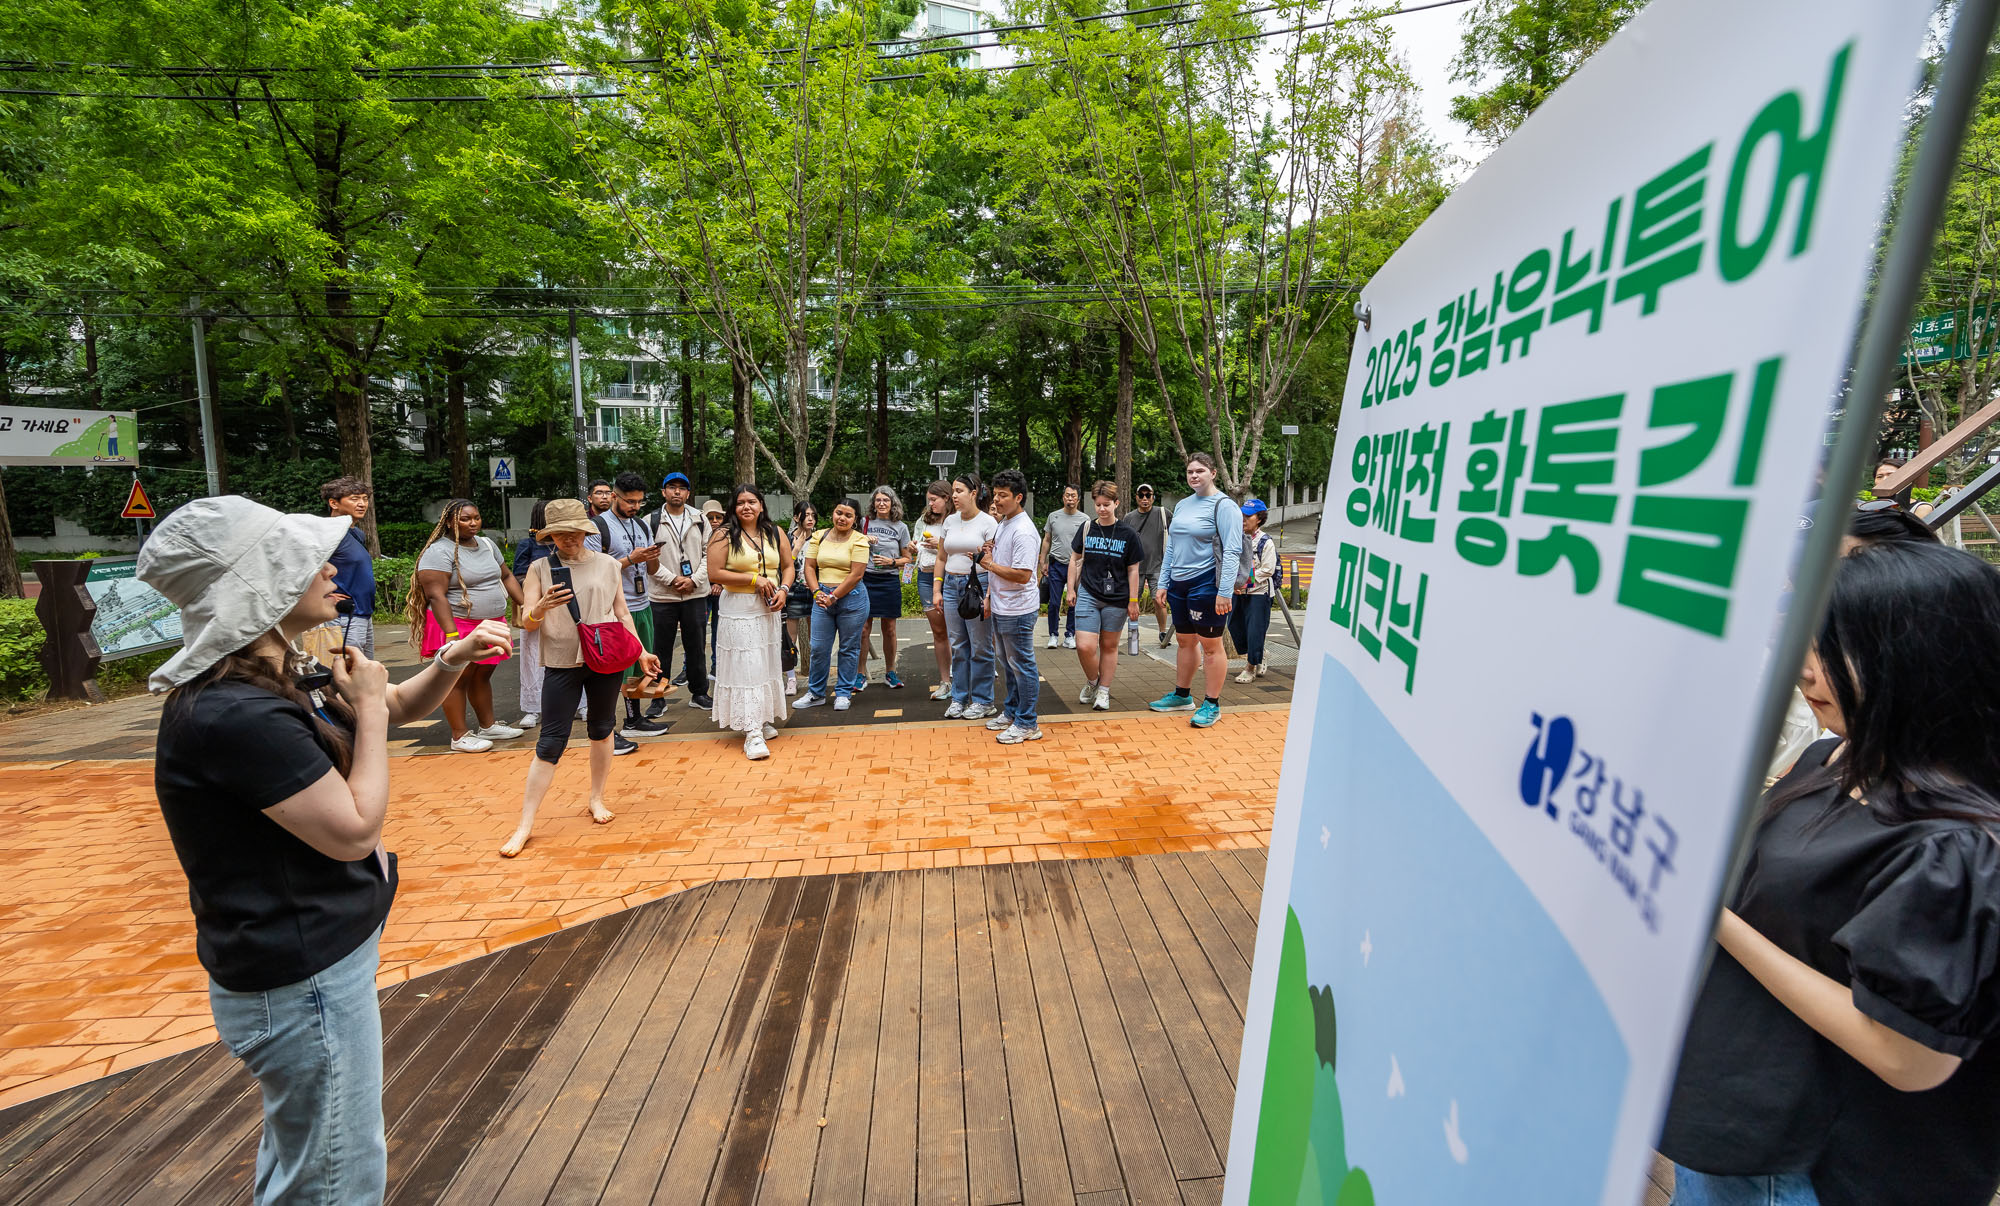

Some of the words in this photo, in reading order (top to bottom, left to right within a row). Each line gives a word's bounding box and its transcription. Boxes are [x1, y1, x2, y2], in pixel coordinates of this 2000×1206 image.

[1361, 319, 1429, 409] 2025
[1429, 43, 1854, 389] 강남유닉투어
[1346, 421, 1451, 544] 양재천
[1456, 356, 1785, 639] 황톳길
[1330, 541, 1429, 695] 피크닉
[1573, 749, 1679, 892] 강남구
